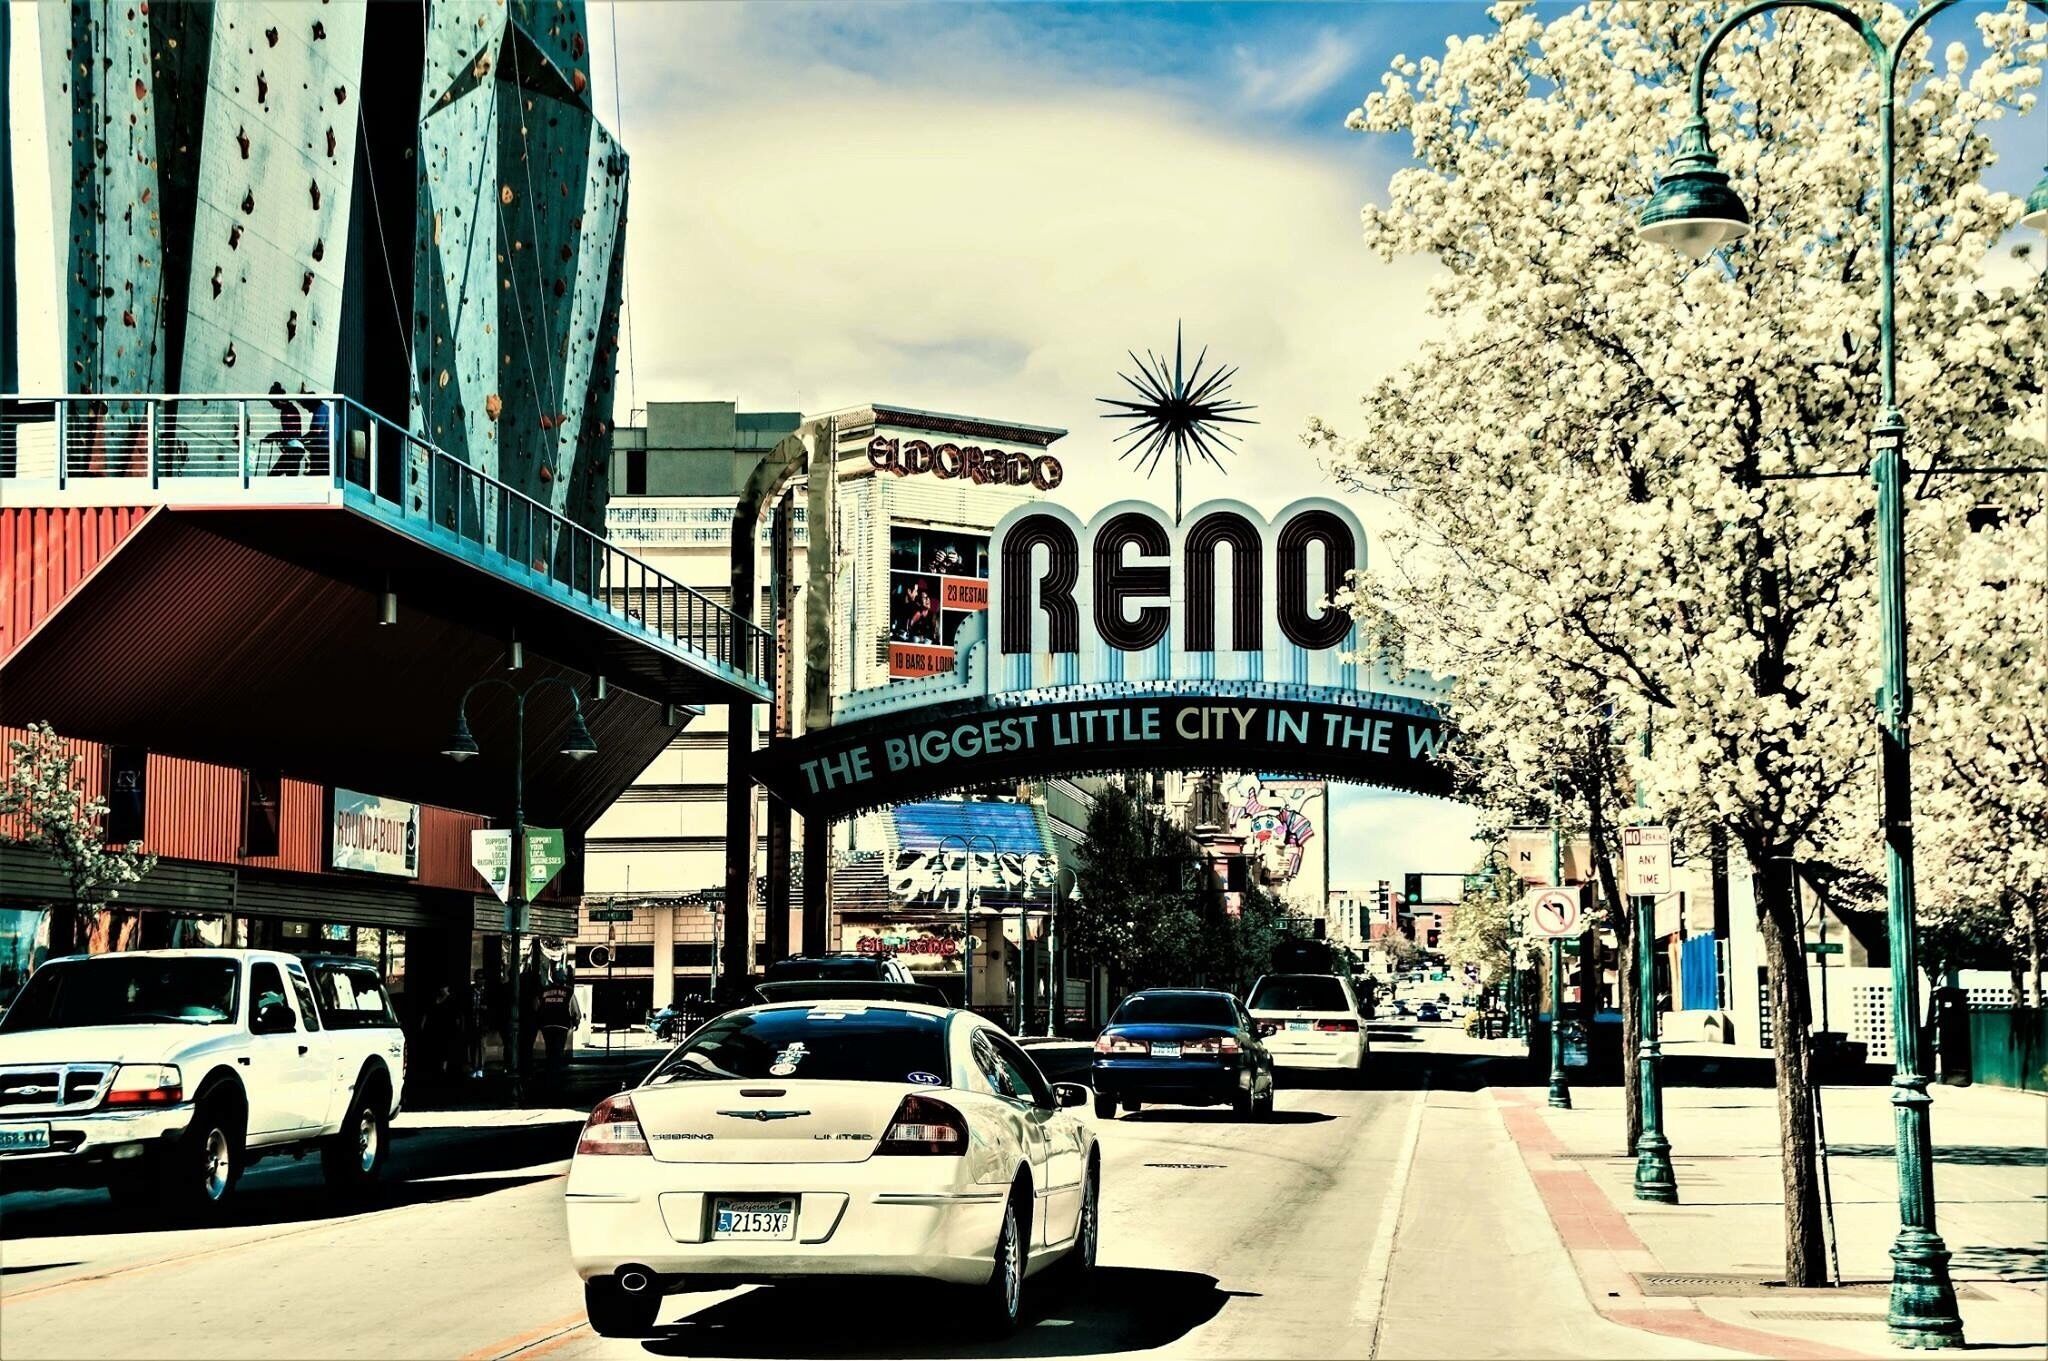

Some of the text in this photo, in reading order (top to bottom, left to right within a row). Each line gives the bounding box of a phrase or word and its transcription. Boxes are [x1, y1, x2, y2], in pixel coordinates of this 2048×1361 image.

[867, 435, 1063, 491] ELDORADO
[1001, 509, 1355, 654] RENO
[947, 585, 958, 602] 23
[905, 653, 926, 671] BARS
[927, 655, 934, 671] &
[800, 746, 873, 794] THE
[885, 715, 1038, 772] BIGGEST
[1052, 707, 1160, 746] LITTLE
[1175, 707, 1257, 740] CITY
[1266, 709, 1310, 744] IN
[1323, 713, 1393, 754] THE
[337, 810, 405, 856] ROUNDABOUT
[1625, 830, 1640, 845] NO
[529, 836, 552, 844] SUPPORT
[477, 858, 508, 866] BUSINESSES
[530, 857, 561, 865] BUSINESSES
[1520, 851, 1532, 862] N
[1638, 855, 1656, 865] ANY
[1638, 873, 1660, 885] TIME
[914, 1074, 935, 1083] LT
[814, 1133, 873, 1141] LIMITED
[732, 1213, 782, 1233] 2153X
